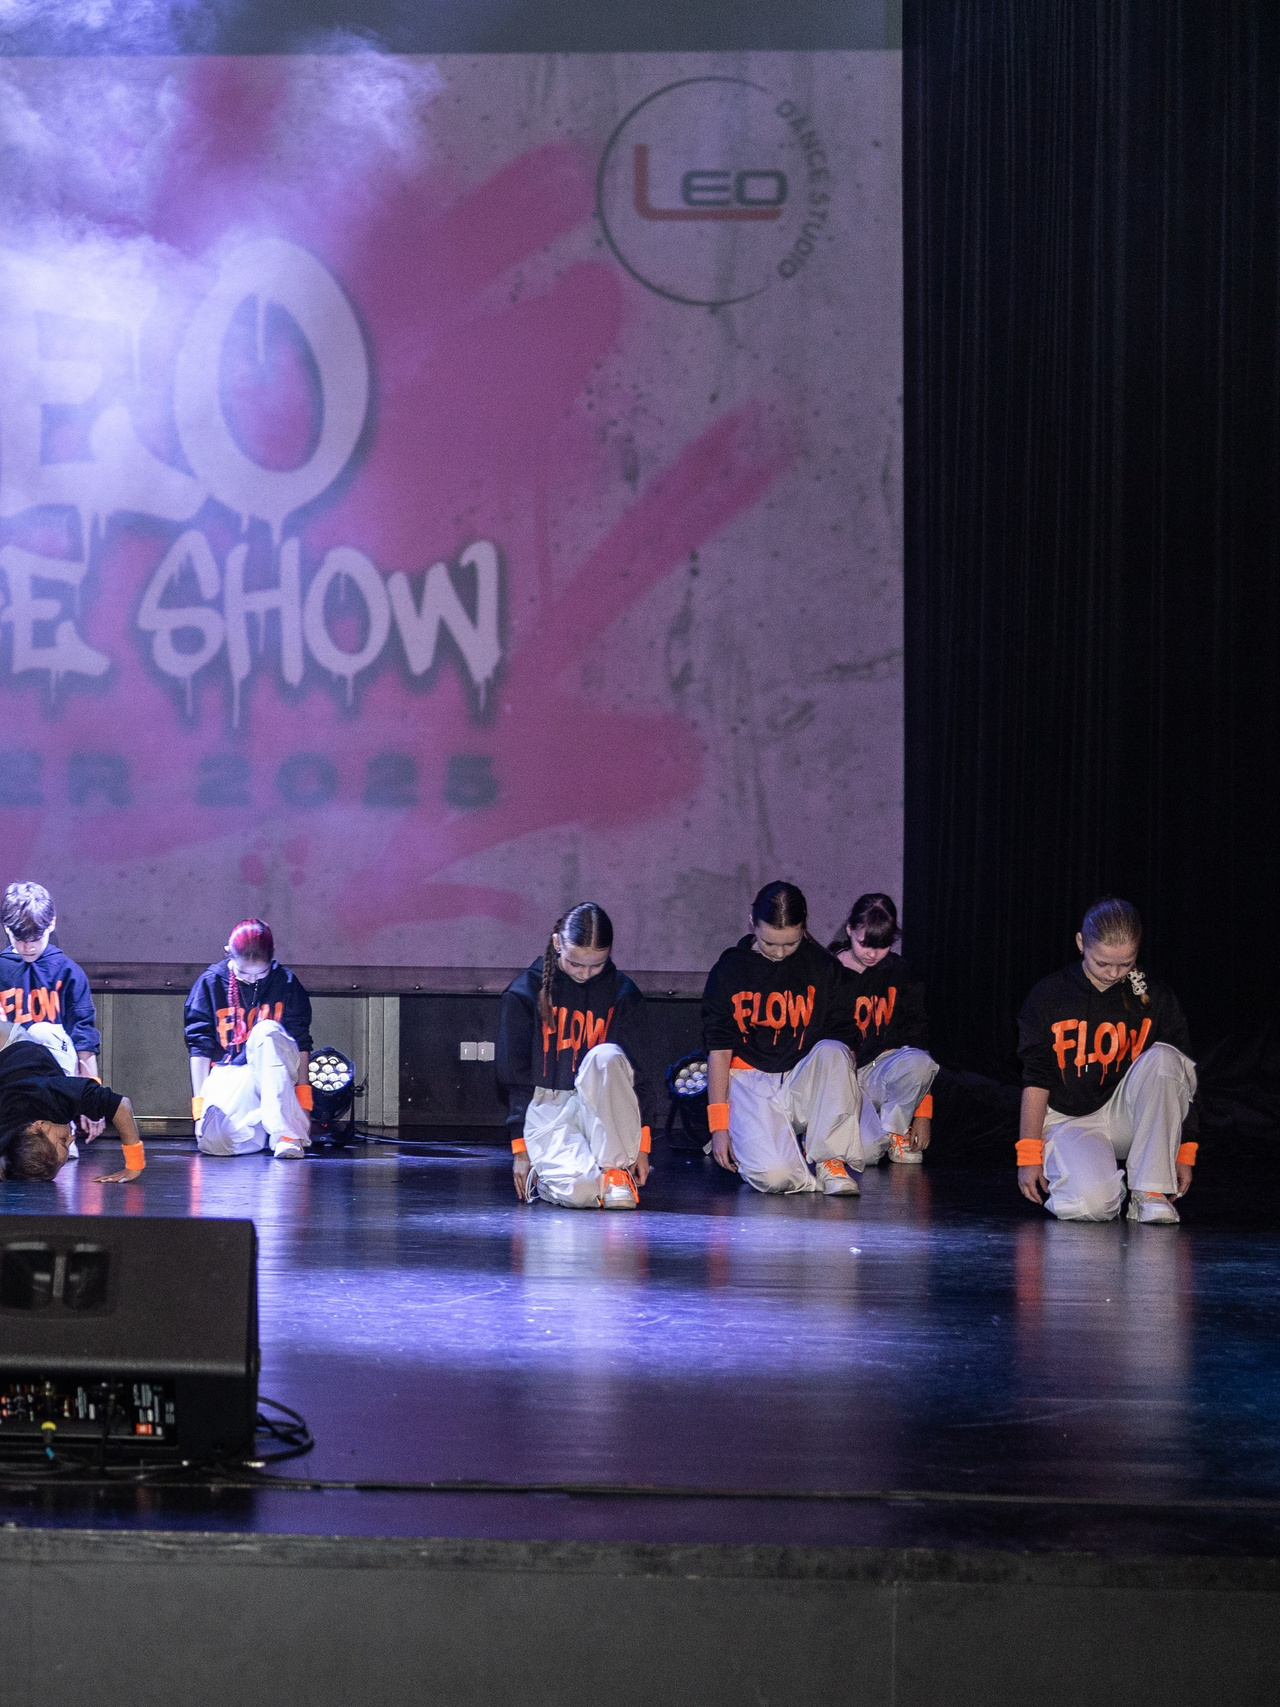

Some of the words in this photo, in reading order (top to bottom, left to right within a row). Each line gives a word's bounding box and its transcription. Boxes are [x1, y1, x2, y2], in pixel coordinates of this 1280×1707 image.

[776, 100, 830, 183] DANCE
[633, 143, 788, 221] LEO
[778, 192, 830, 279] STUDIO
[137, 529, 502, 722] SHOW
[195, 751, 500, 807] 2025
[731, 985, 816, 1050] FLOW
[853, 986, 897, 1041] OW
[1051, 1018, 1152, 1085] FLOW
